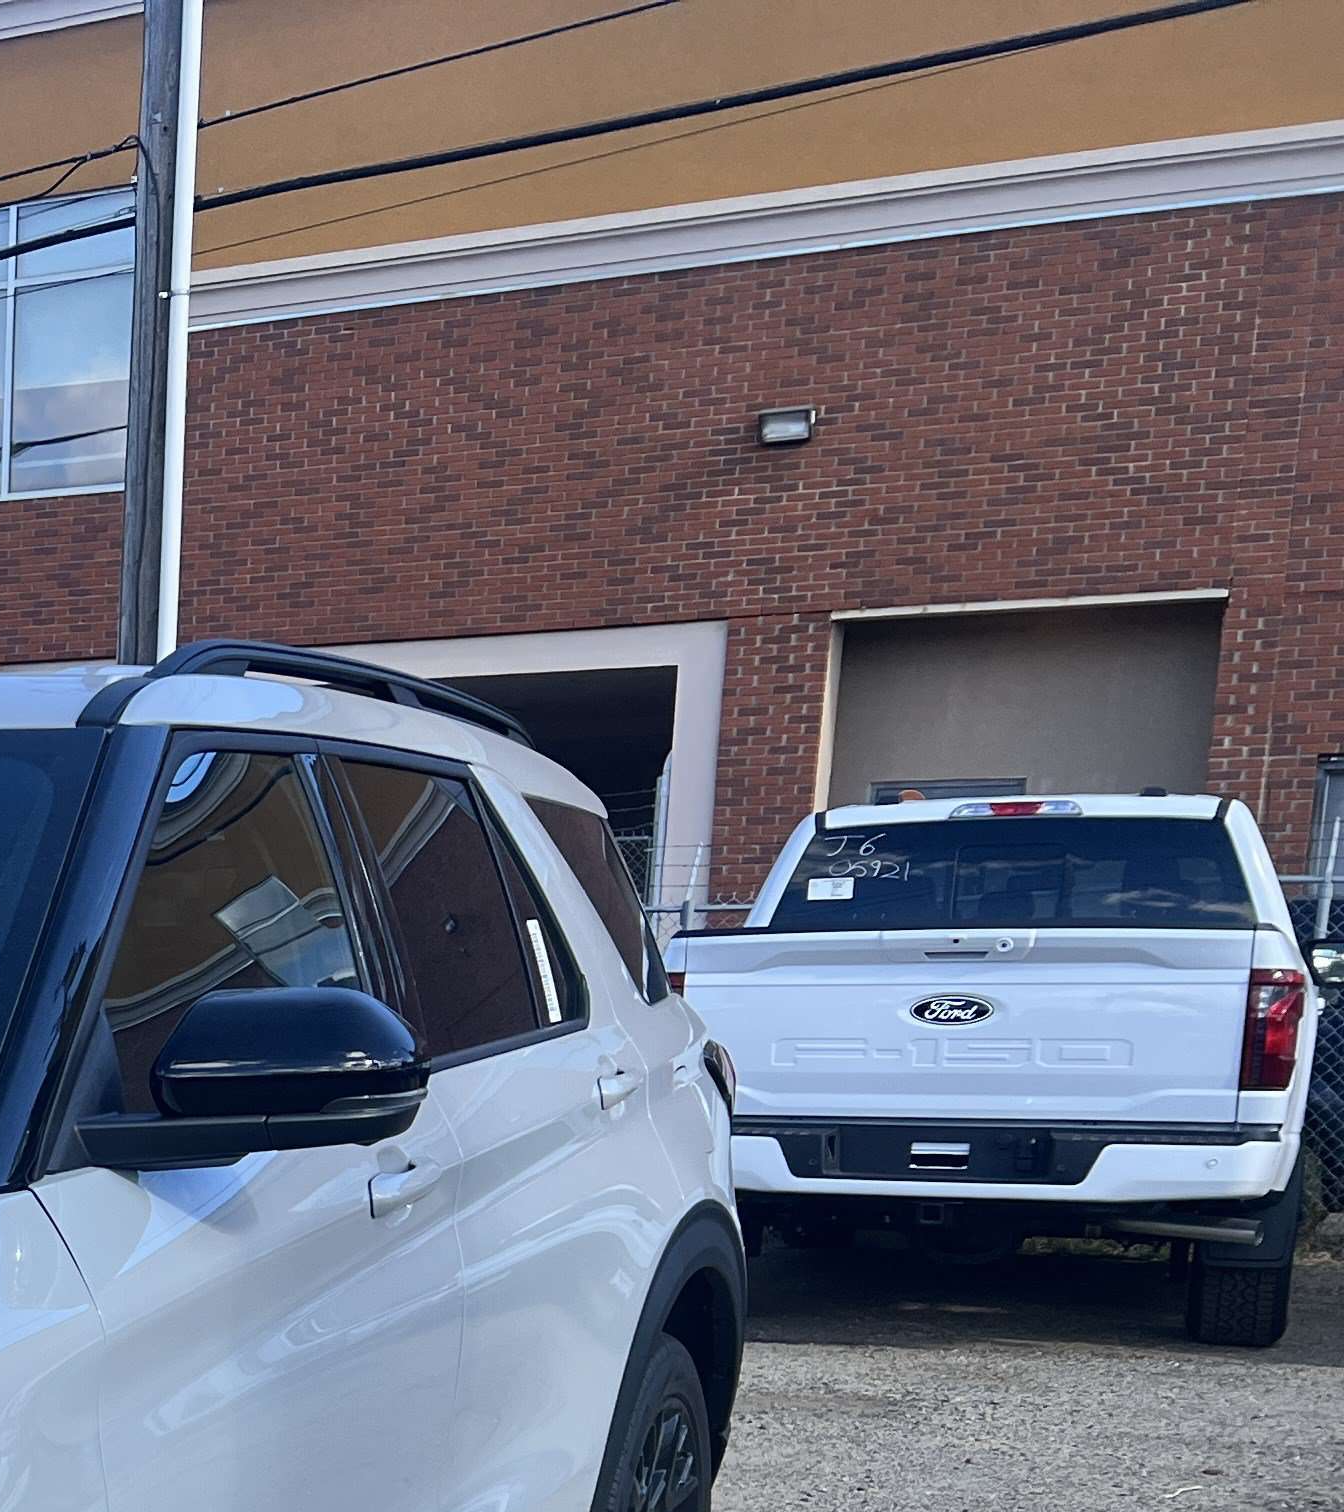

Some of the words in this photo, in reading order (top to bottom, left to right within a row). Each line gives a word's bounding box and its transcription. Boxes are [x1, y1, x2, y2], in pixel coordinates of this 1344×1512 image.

[829, 860, 910, 881] 05921
[924, 1000, 977, 1020] Ford
[771, 1037, 1135, 1068] F-150
